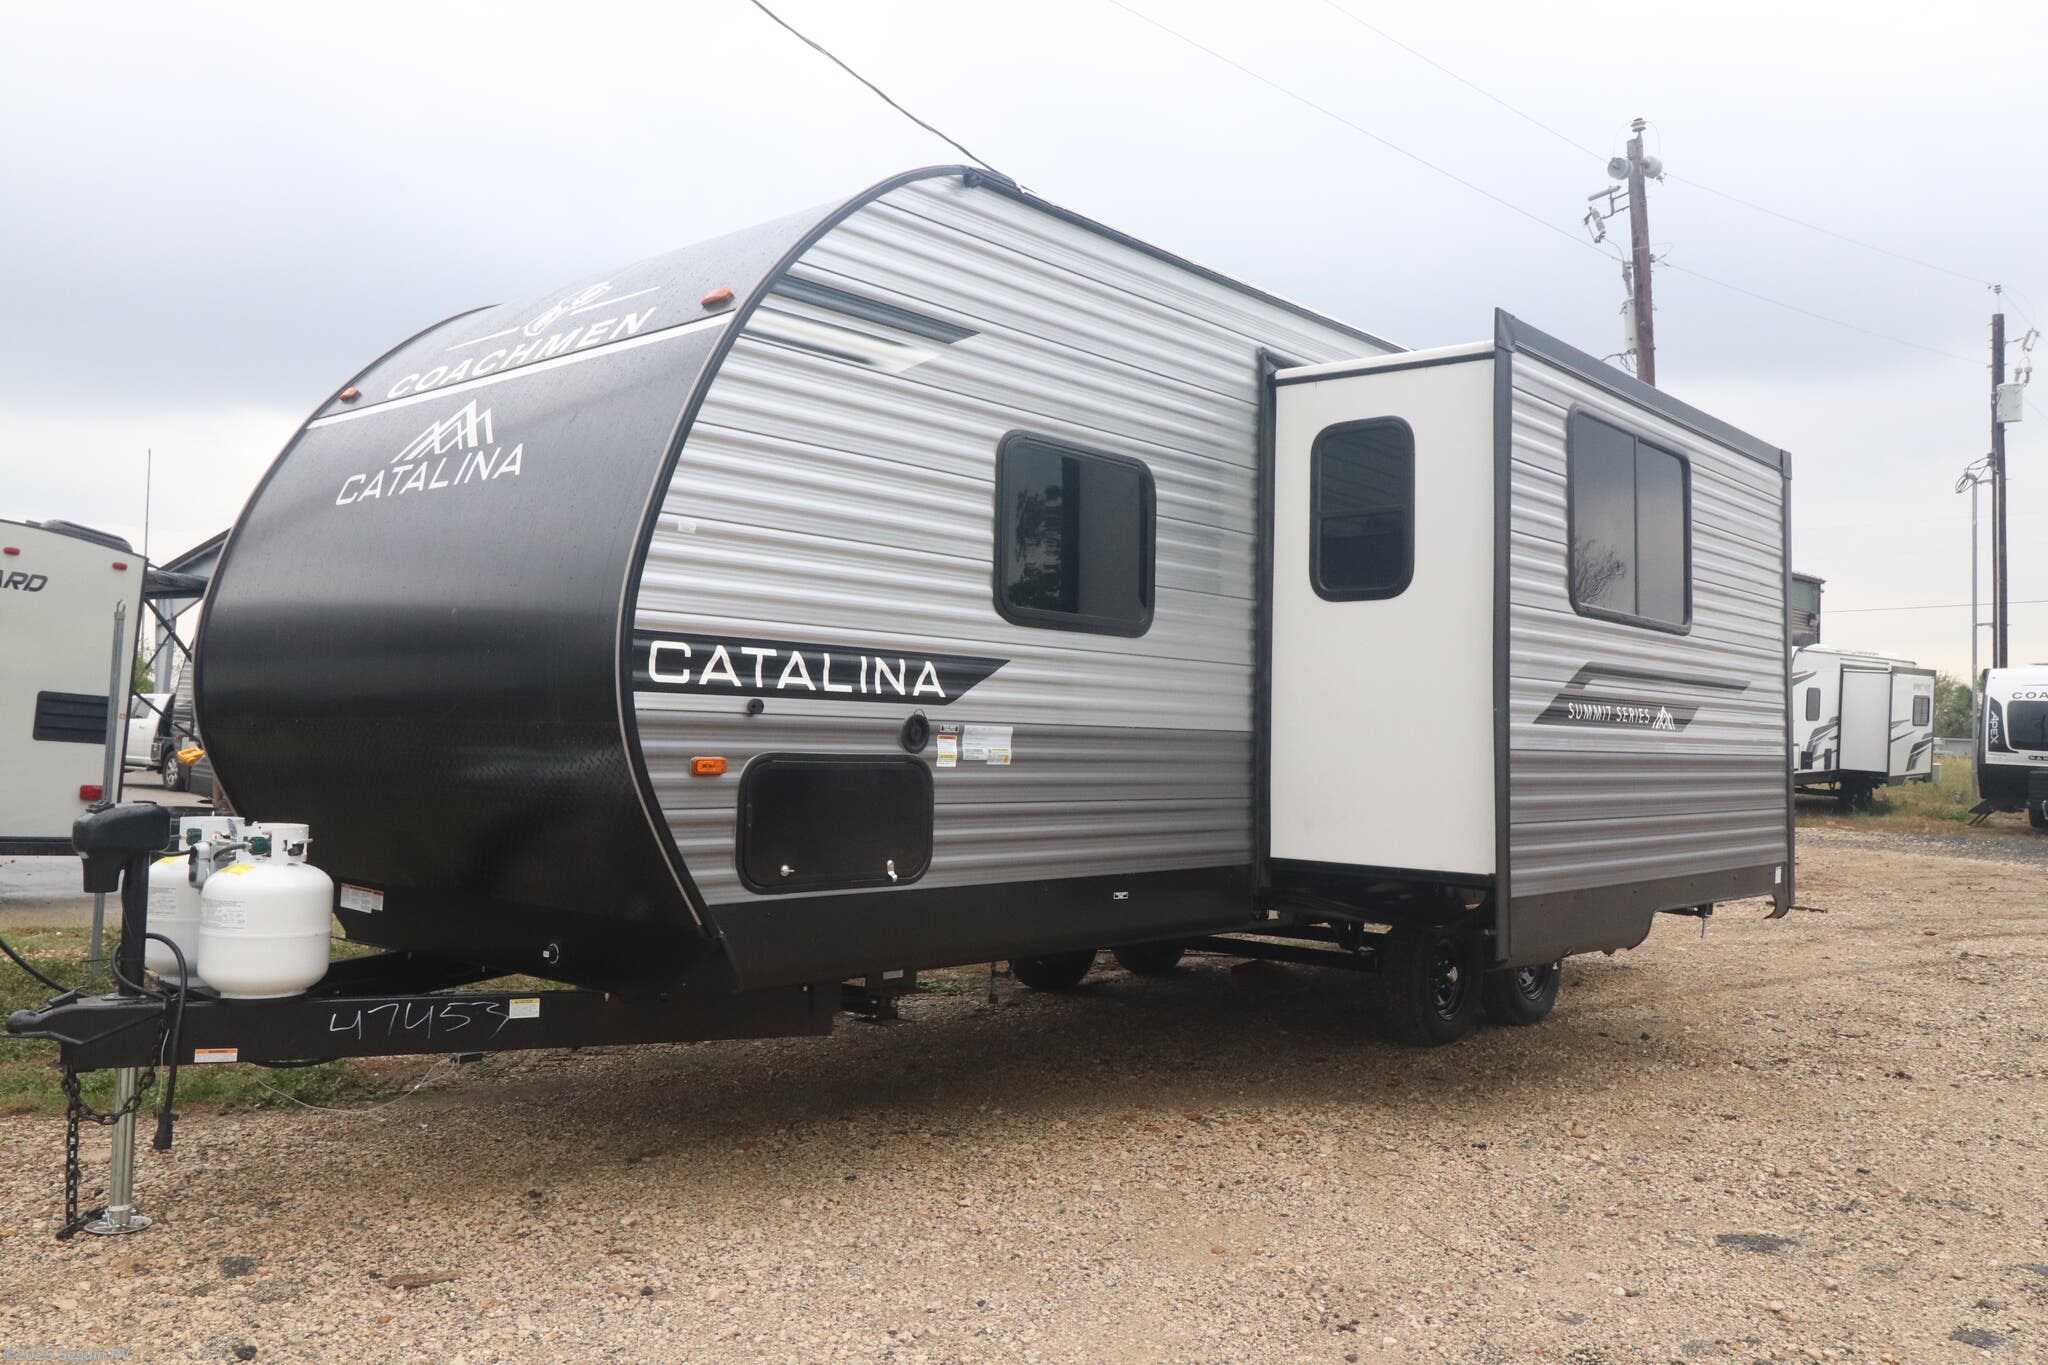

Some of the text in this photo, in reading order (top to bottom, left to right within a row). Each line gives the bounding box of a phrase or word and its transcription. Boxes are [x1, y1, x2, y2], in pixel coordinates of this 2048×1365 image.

[386, 307, 657, 399] COACHMEN
[335, 443, 524, 506] CATALINA
[648, 640, 946, 698] CATALINA
[1567, 702, 1650, 724] SUMMIT SERIES
[1989, 711, 2000, 744] APEX
[329, 1000, 510, 1040] 47453
